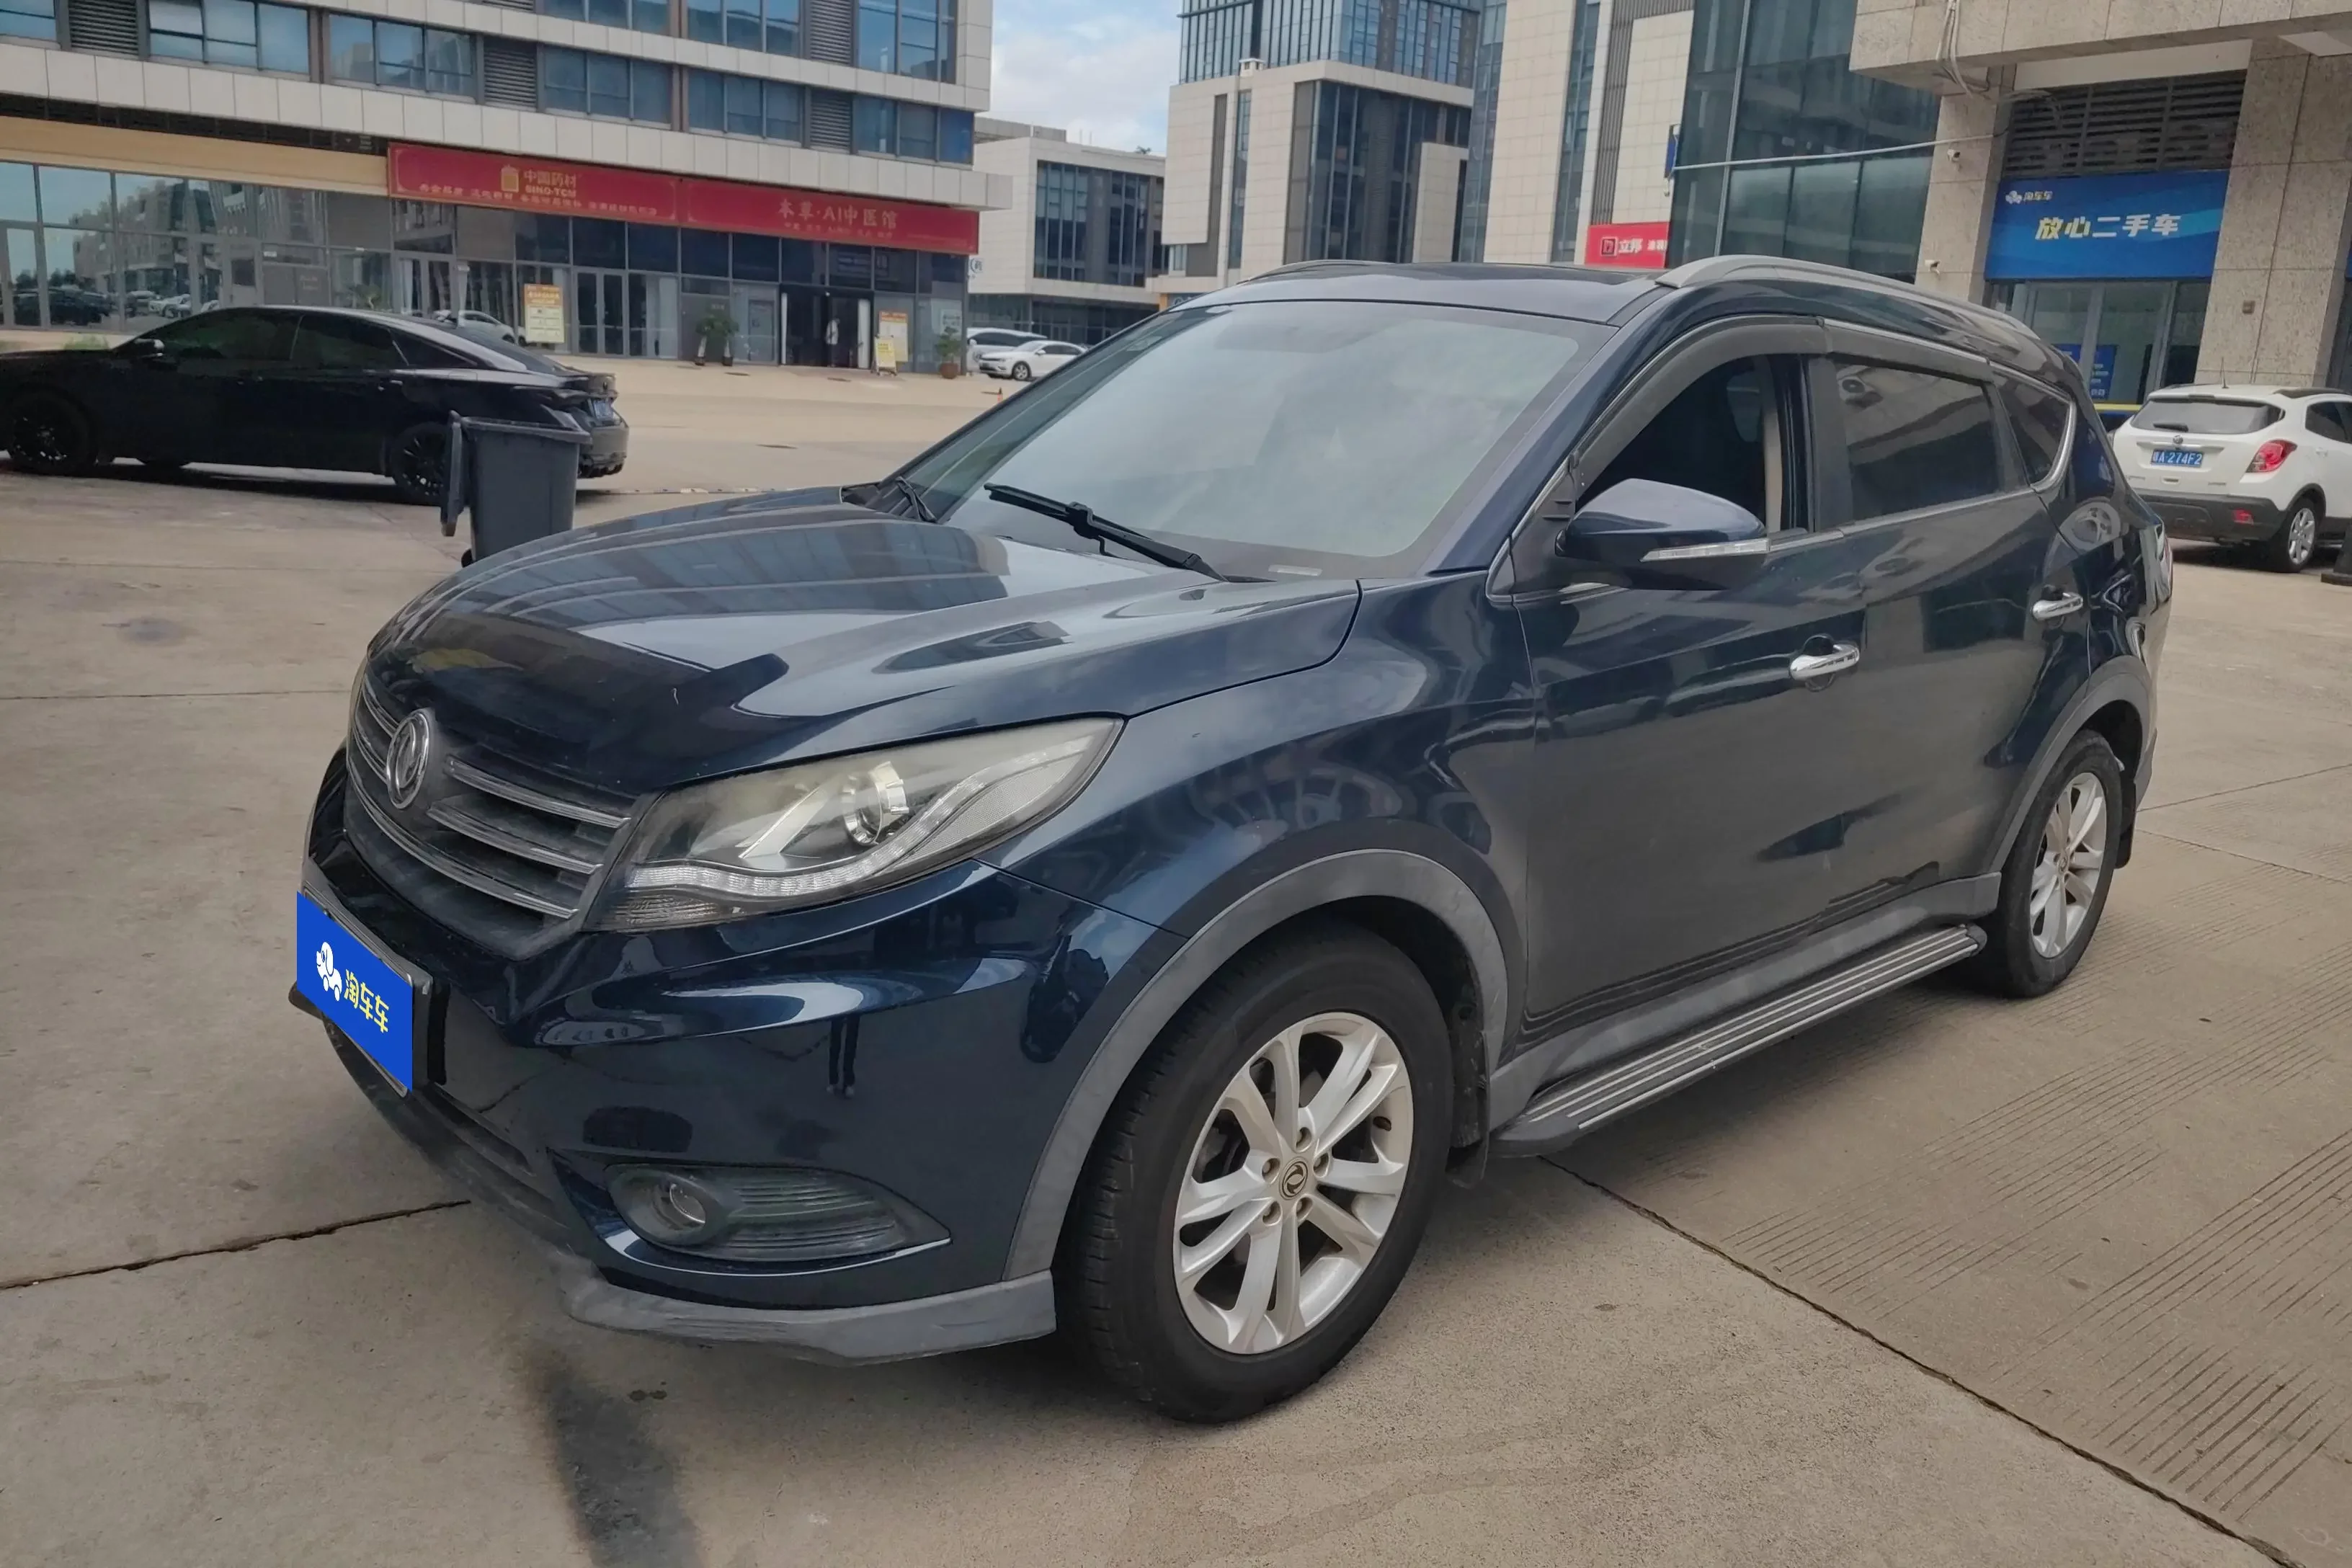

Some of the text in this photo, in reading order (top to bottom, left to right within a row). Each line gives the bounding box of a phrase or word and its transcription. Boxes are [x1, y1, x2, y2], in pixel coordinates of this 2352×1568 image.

[525, 184, 576, 198] SINO-TCM
[2035, 214, 2181, 240] 放心二手车
